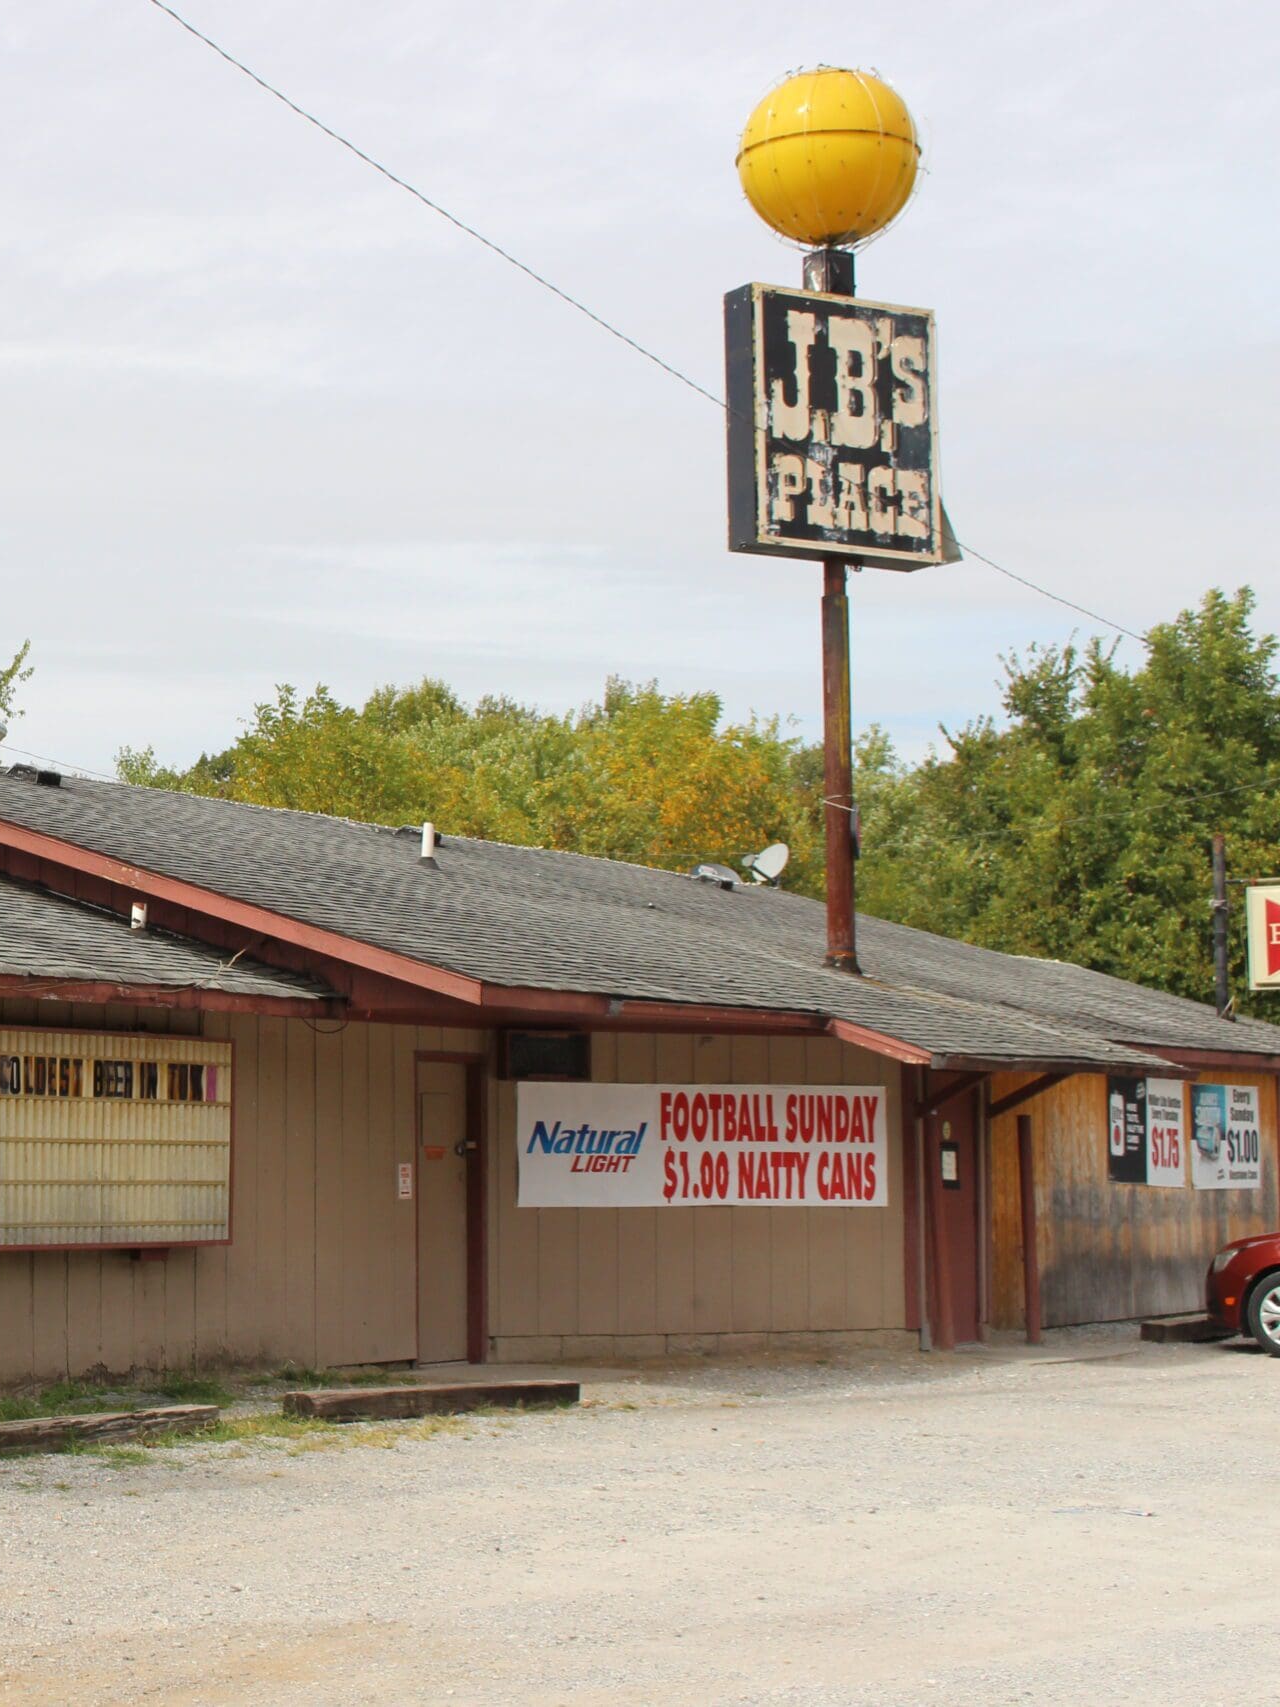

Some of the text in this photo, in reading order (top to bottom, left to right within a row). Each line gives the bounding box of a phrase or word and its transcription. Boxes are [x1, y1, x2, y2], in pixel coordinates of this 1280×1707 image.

[772, 453, 929, 538] PLACE
[660, 1092, 879, 1144] FOOTBALL SUNDAY
[1230, 1107, 1254, 1123] Sunday
[526, 1120, 648, 1156] Natural
[1151, 1124, 1179, 1170] $1.75
[1227, 1128, 1258, 1165] $1.00
[570, 1155, 637, 1173] LIGHT
[662, 1146, 876, 1203] $1.00 NATTY CANS
